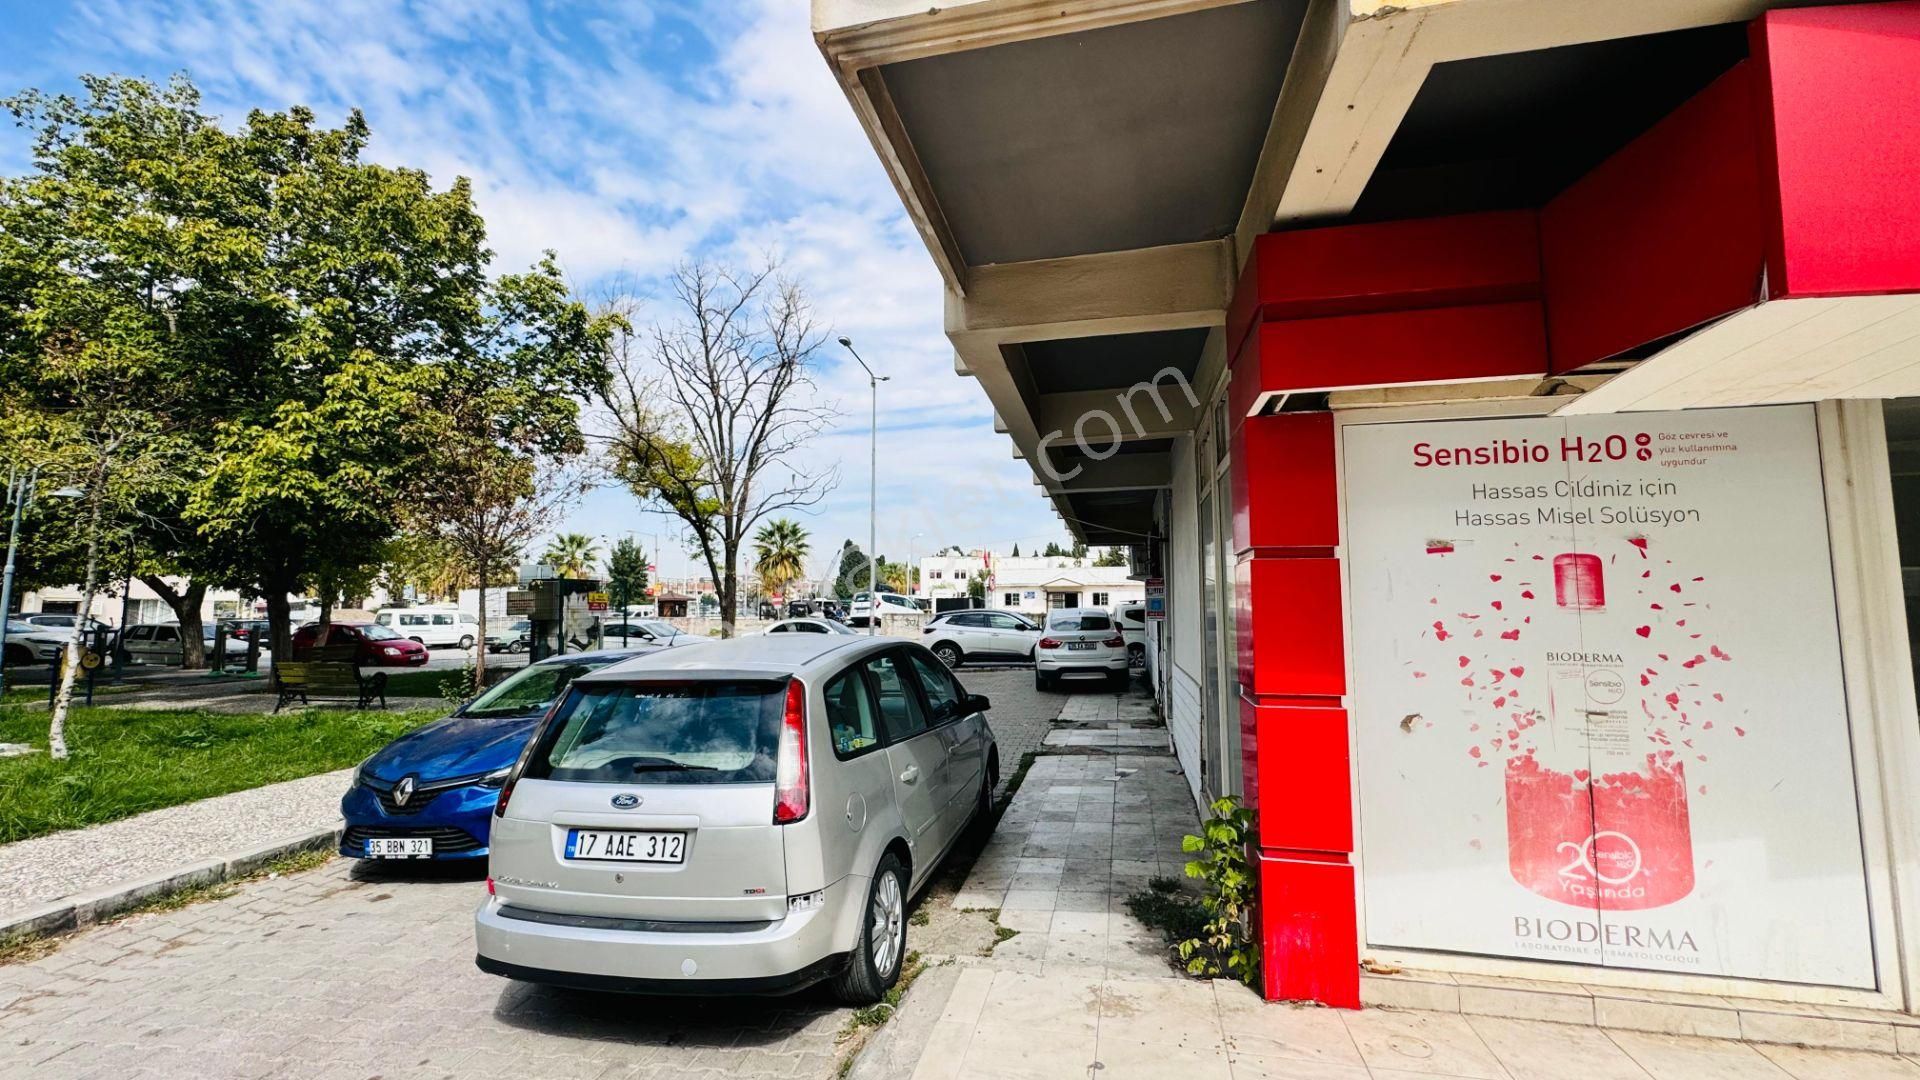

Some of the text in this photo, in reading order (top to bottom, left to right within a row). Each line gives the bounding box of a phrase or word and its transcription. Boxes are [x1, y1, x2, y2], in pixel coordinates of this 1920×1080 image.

[1717, 431, 1729, 439] ve
[1413, 434, 1628, 467] Sensibio H2O
[1660, 457, 1708, 468] uygundur
[1472, 478, 1677, 500] Hassas Cildiniz için
[1455, 506, 1700, 528] Hassas Misel Solüsyon
[1546, 651, 1624, 663] BIODERMA
[370, 840, 428, 853] 35 BBN 321
[579, 834, 598, 856] 17
[605, 835, 637, 857] AAE
[647, 836, 681, 858] 312
[1556, 831, 1642, 885] 20
[1558, 876, 1645, 899] Yaşında
[1514, 916, 1699, 952] BIODERMA
[1515, 942, 1590, 955] LABORATOIRE
